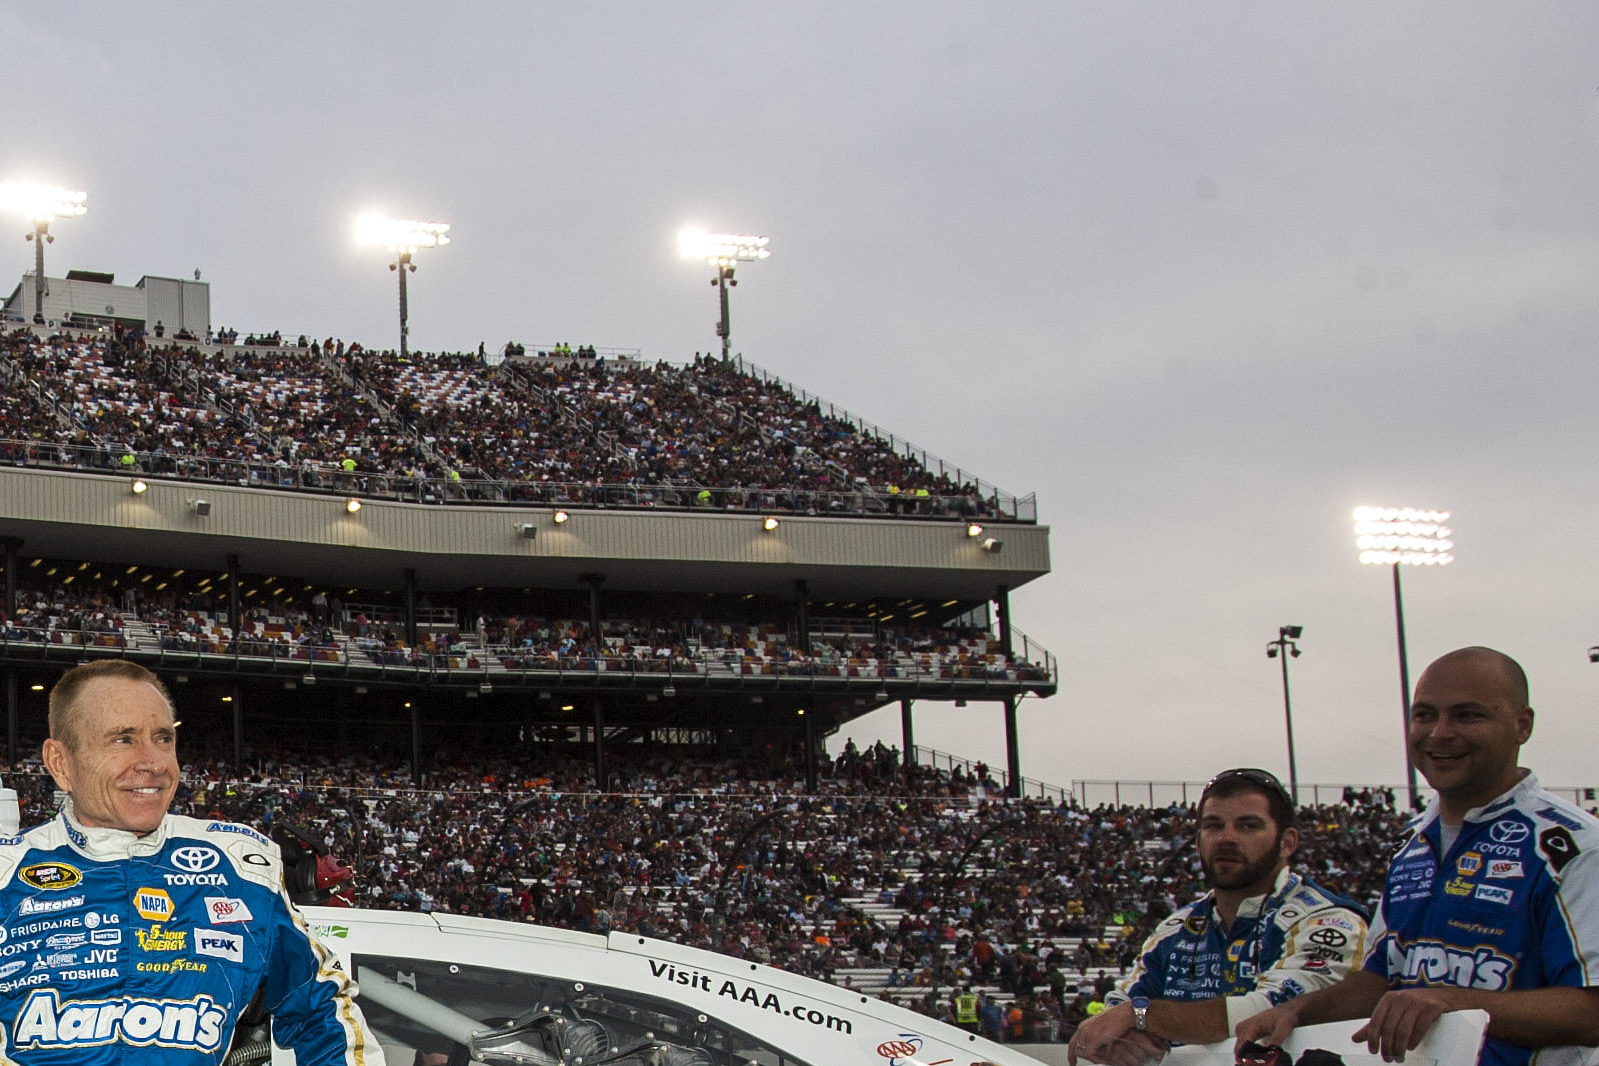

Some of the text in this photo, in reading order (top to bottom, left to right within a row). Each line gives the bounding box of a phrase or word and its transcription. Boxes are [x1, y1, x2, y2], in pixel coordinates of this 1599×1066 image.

[1472, 841, 1521, 858] TOYOTA
[164, 873, 228, 886] TOYOTA
[19, 895, 85, 916] Aaron's
[141, 895, 168, 913] NAPA
[11, 918, 81, 938] FRIGIDAIRE
[103, 914, 119, 924] LG
[201, 938, 238, 952] PEAK
[84, 949, 118, 964] JVC
[1387, 936, 1515, 993] Aron's
[59, 968, 119, 981] TOSHIBA
[649, 959, 853, 1035] Visit AAA.com
[13, 988, 227, 1052] Aaron's
[877, 1040, 916, 1059] AAA
